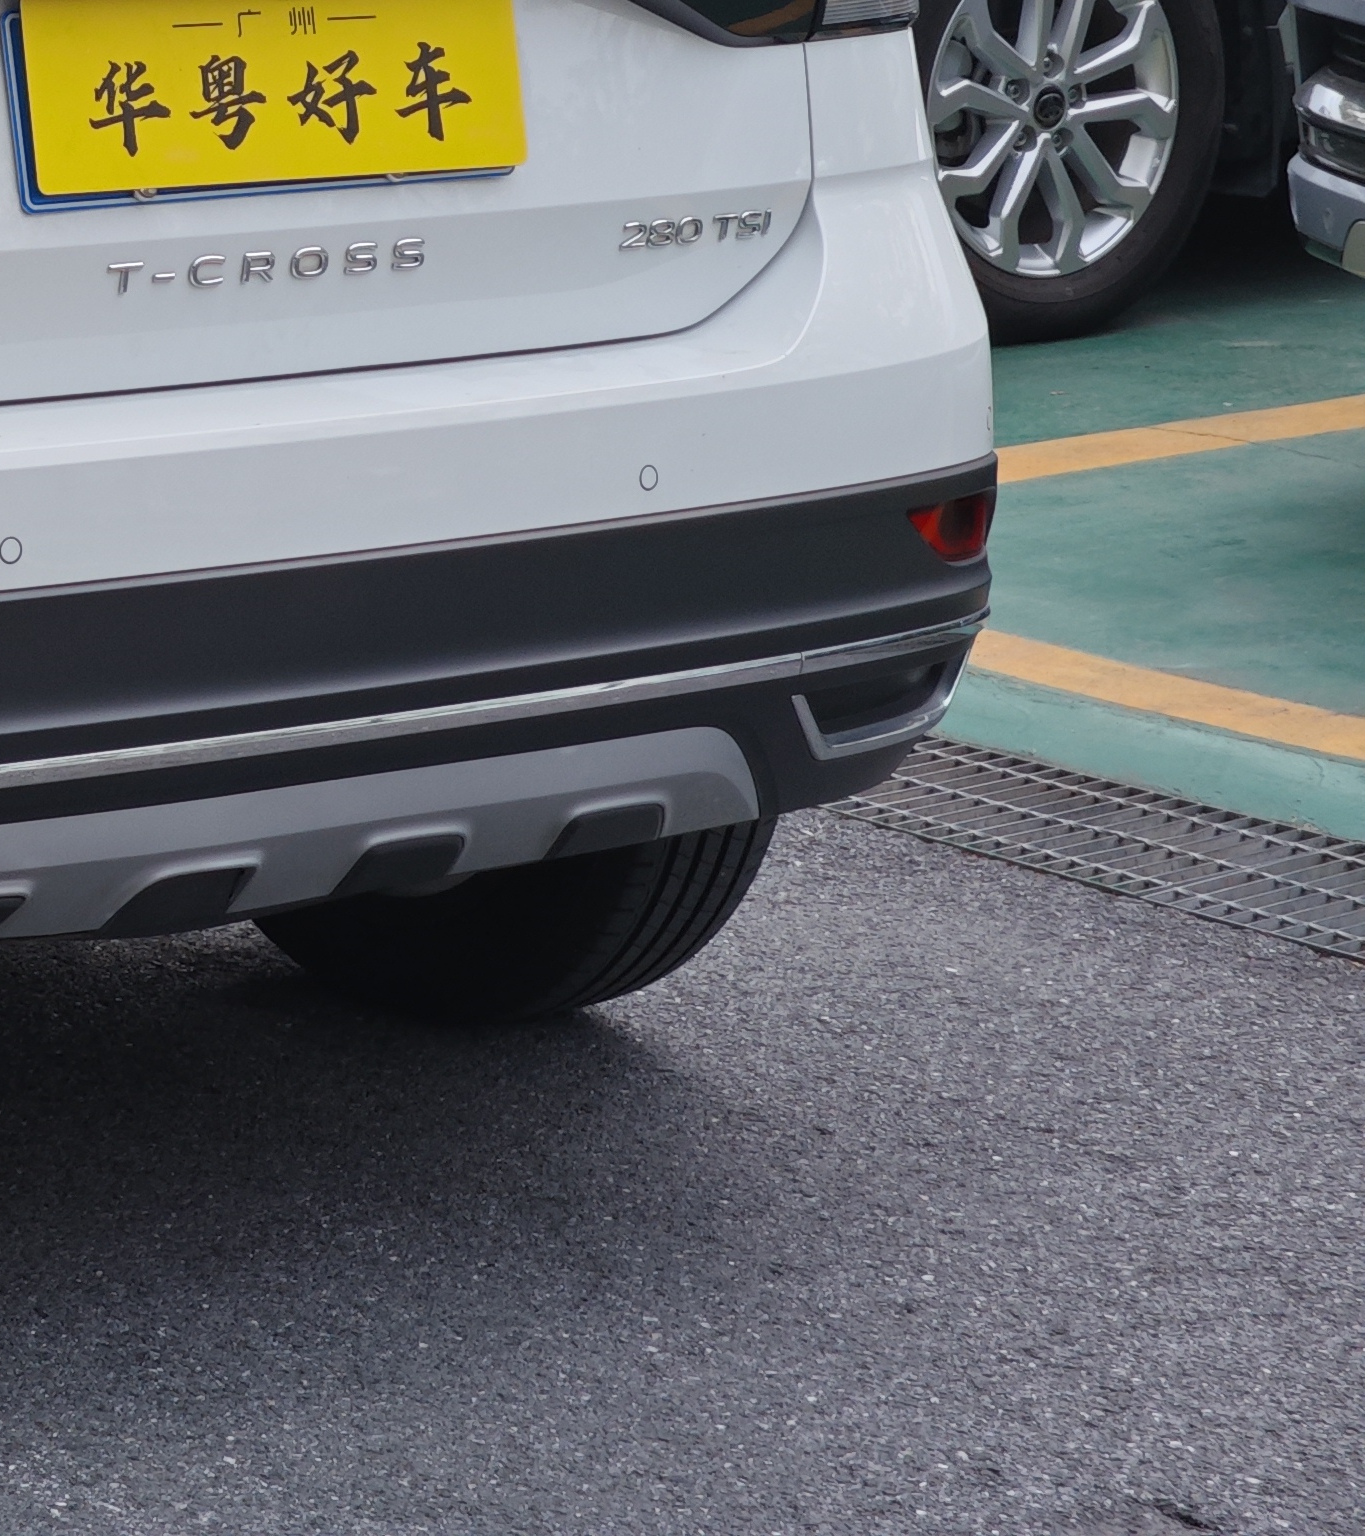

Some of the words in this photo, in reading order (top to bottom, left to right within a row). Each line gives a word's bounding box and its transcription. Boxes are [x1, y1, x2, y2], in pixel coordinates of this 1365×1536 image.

[236, 7, 317, 38] 广州
[88, 41, 473, 158] 华粤好车
[619, 215, 704, 252] 280
[713, 208, 772, 243] TSI
[107, 237, 426, 295] T-CROSS
